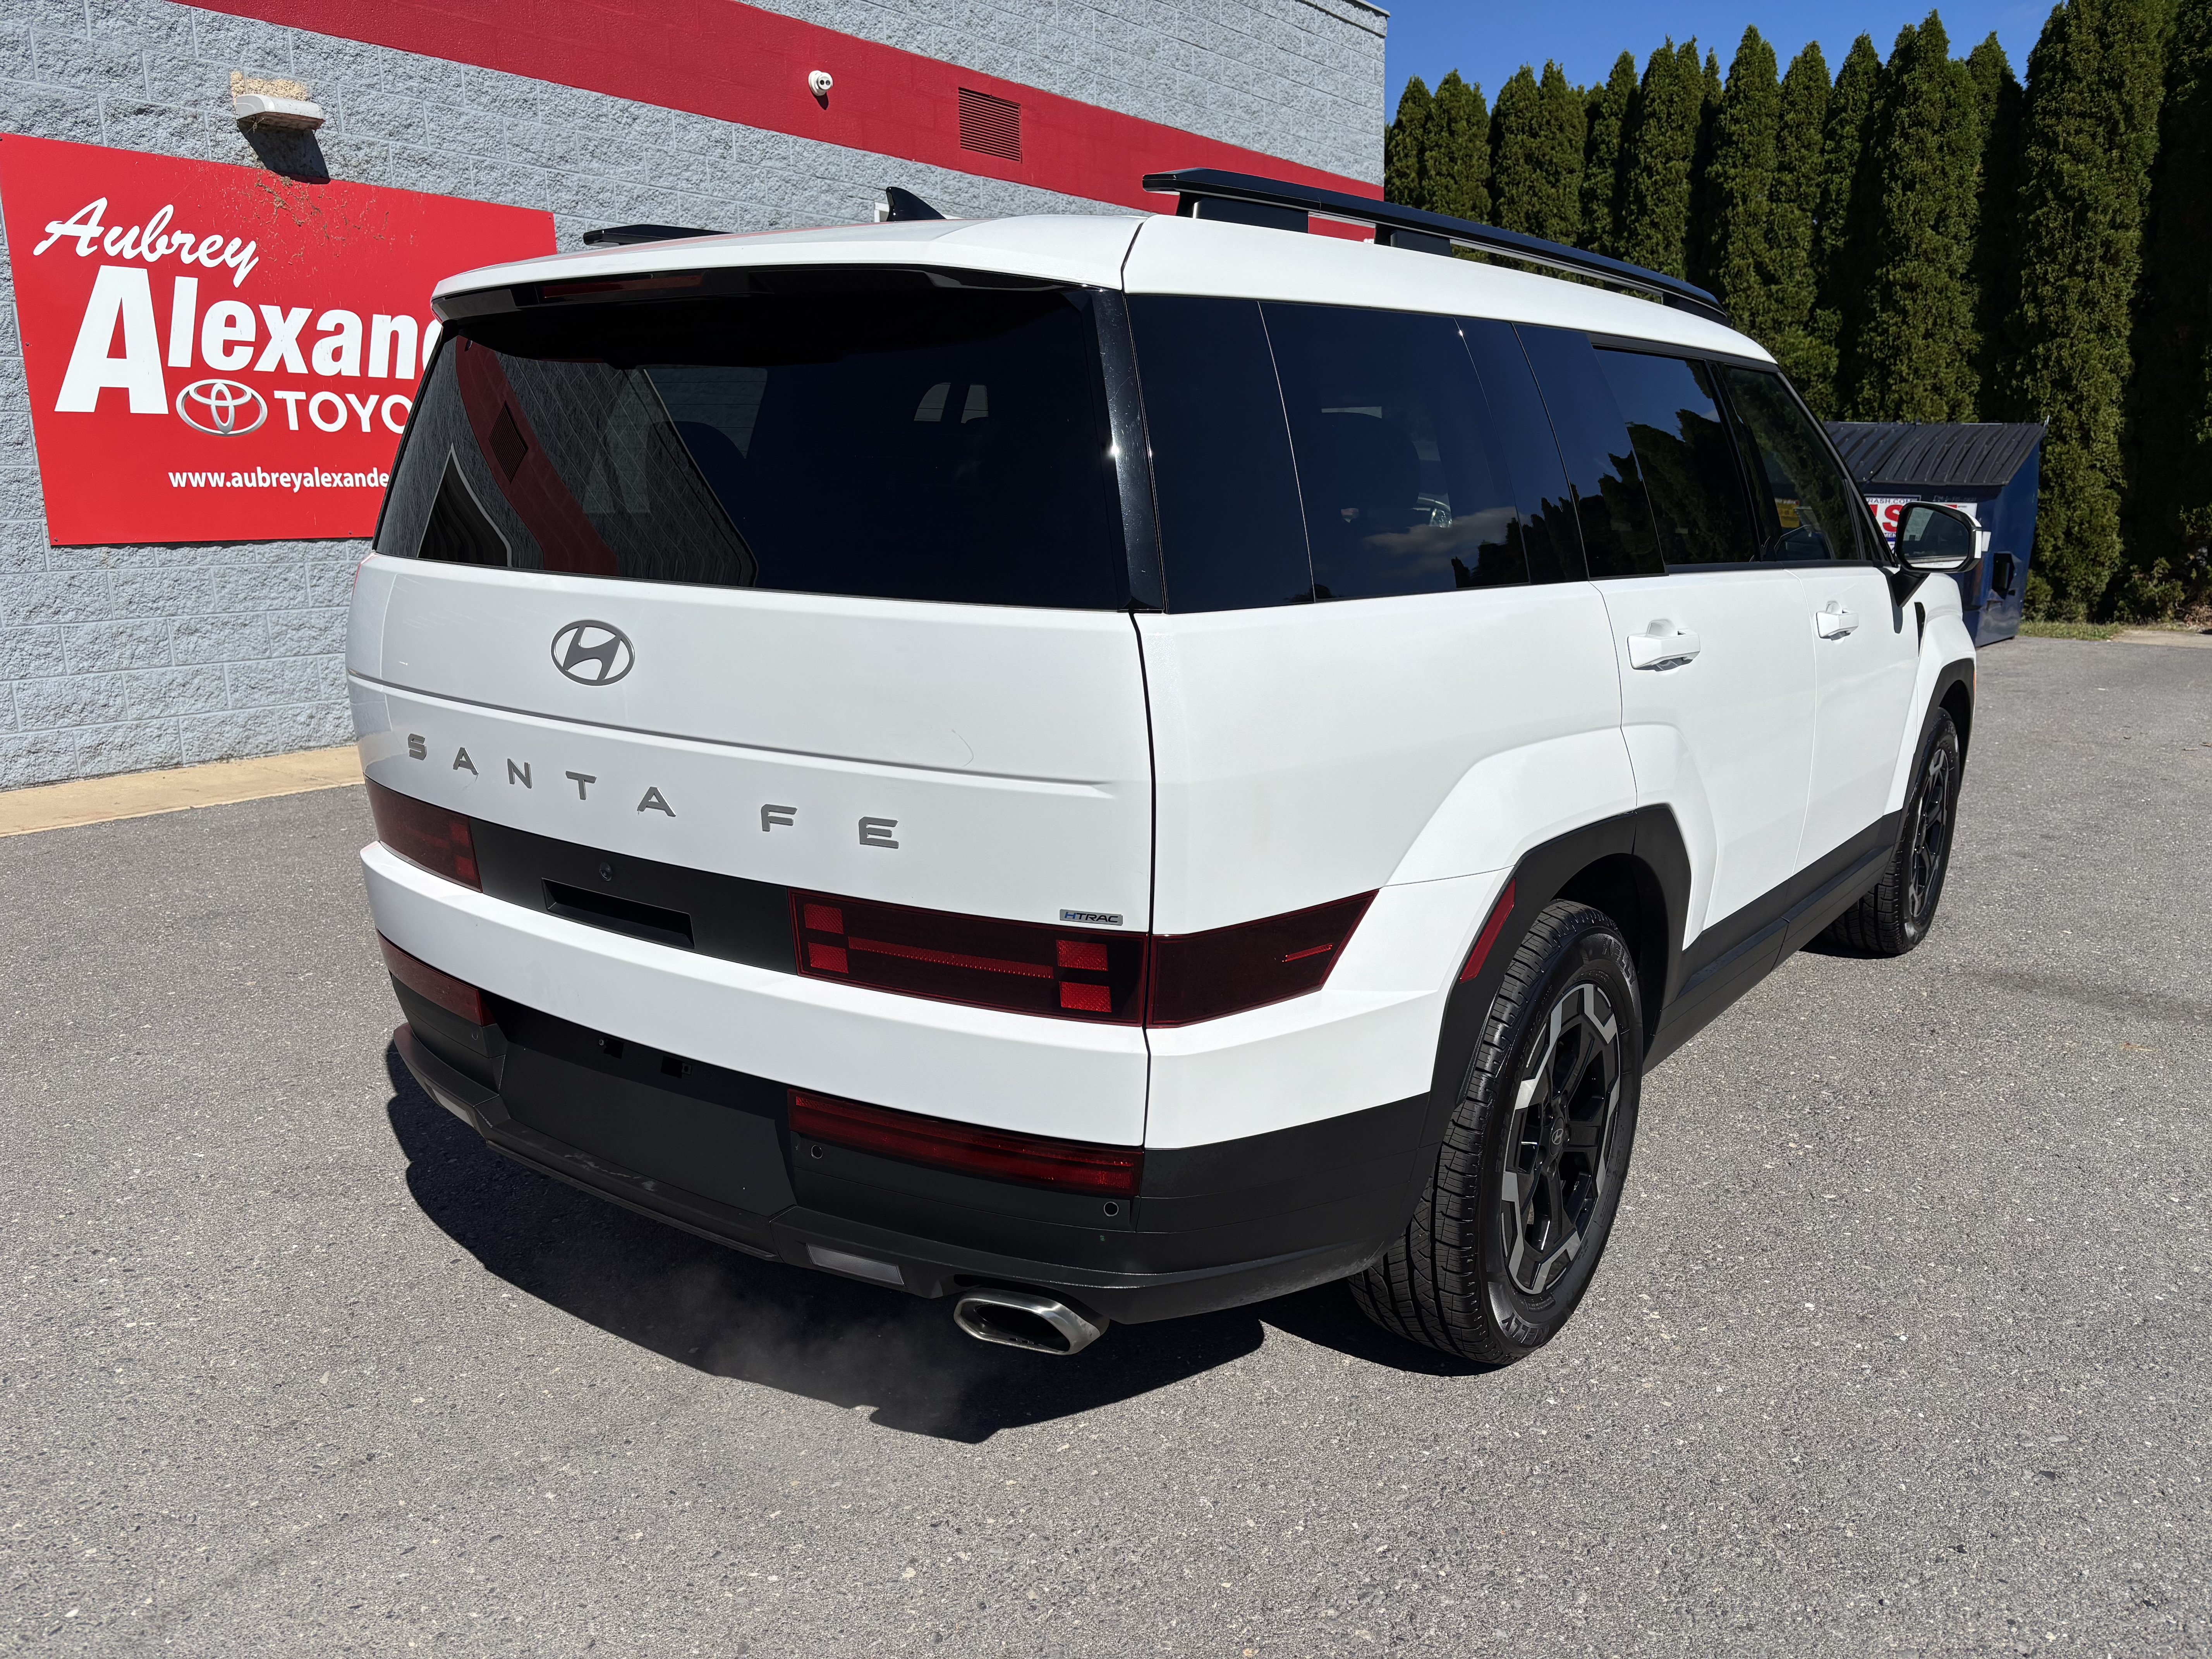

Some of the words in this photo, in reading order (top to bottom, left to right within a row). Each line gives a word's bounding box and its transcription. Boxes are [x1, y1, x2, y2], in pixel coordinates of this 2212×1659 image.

[33, 197, 259, 288] Aubrey
[273, 390, 413, 434] TOYO
[168, 466, 390, 493] www.aubreyalexande
[407, 733, 676, 817] SANTA
[761, 804, 899, 849] FE
[1065, 911, 1118, 923] HTRAC
[1602, 937, 1636, 985] KELLY
[1501, 1312, 1549, 1345] KELLY
